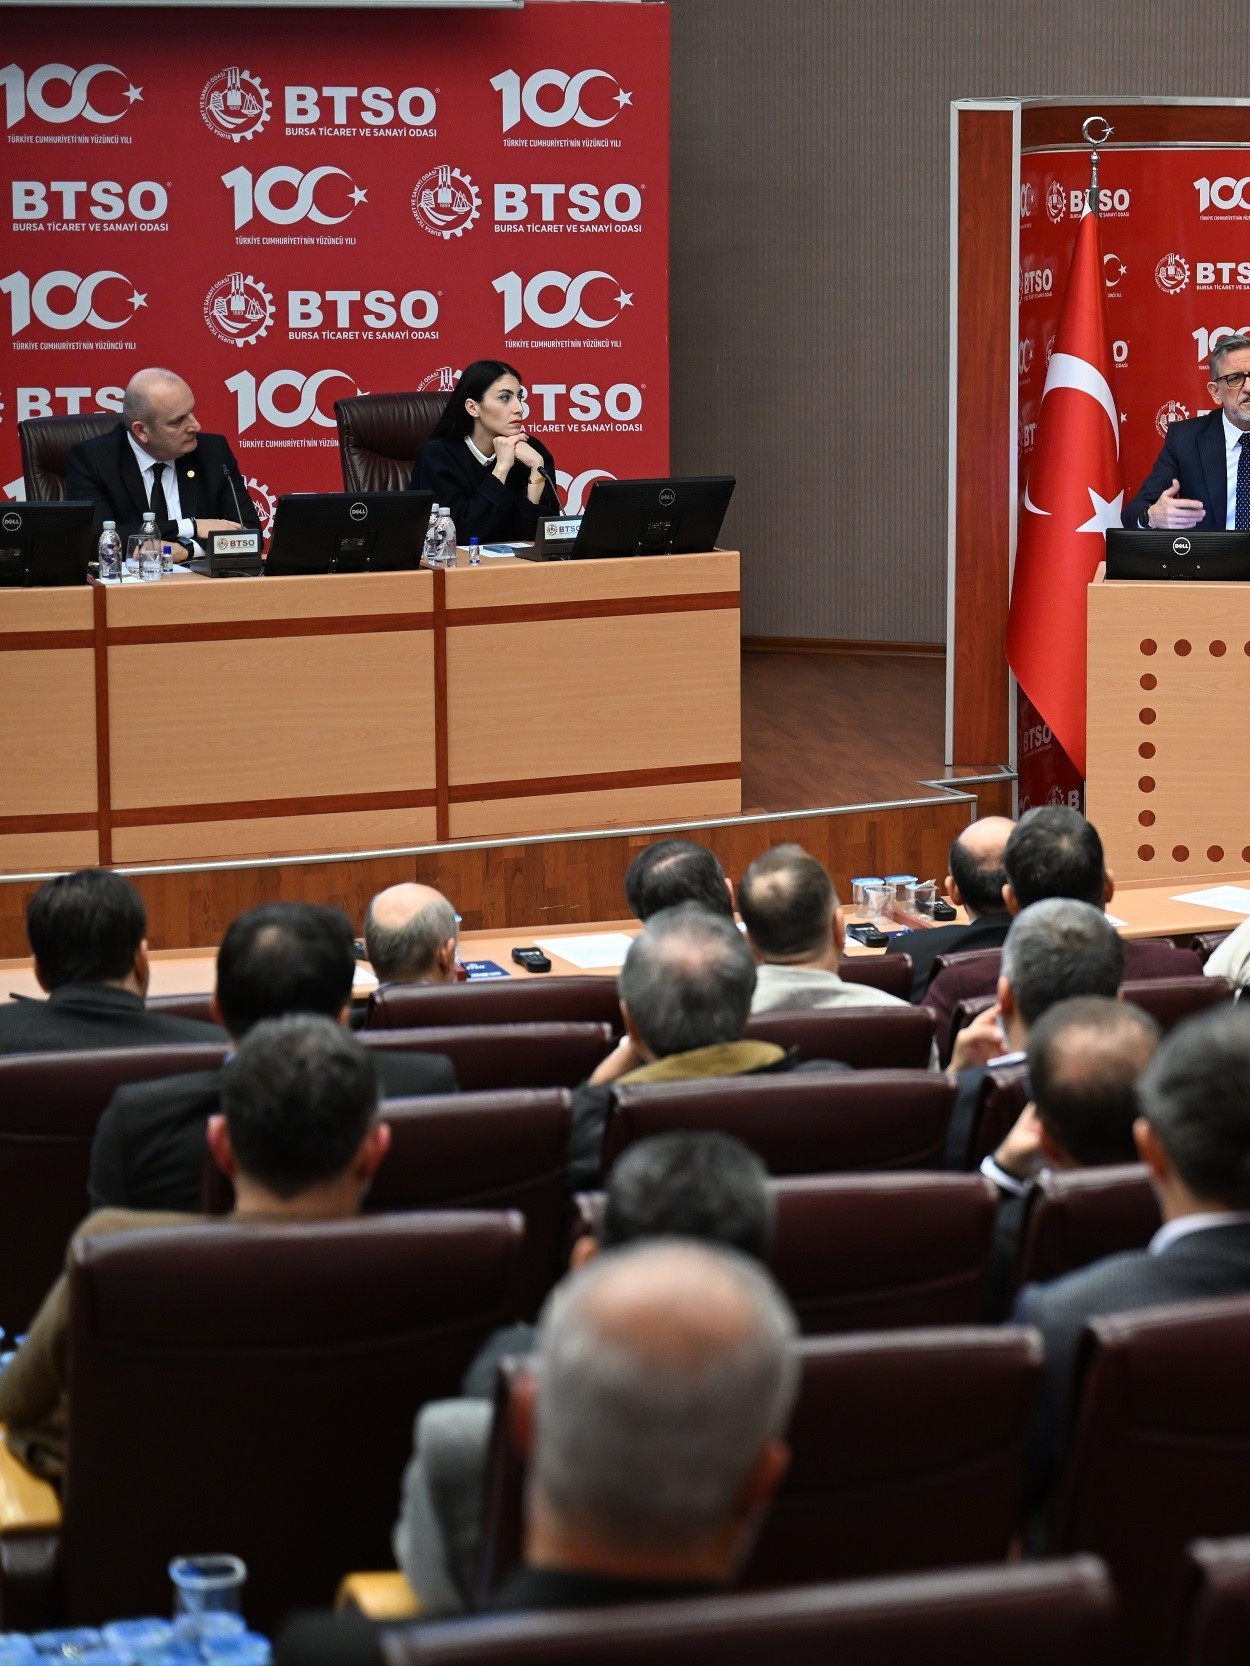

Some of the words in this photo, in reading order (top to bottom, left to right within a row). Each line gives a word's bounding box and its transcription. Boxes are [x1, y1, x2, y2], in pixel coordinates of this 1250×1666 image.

[286, 128, 316, 136] BURSA
[319, 127, 357, 136] TİCARET
[359, 128, 371, 136] VE
[373, 127, 406, 137] SANAYİ
[409, 128, 437, 137] ODASI
[8, 133, 33, 144] TÜRKİYE
[35, 133, 89, 144] CUMHURİYETİ'NİN
[91, 134, 119, 144] YÜZÜNCÜ
[120, 136, 132, 144] YILI
[503, 137, 528, 148] TÜRKİYE
[530, 137, 580, 148] CUMHURİYETİ'NİN
[582, 137, 608, 148] YÜZÜNCÜ
[610, 139, 621, 148] YILI
[1070, 189, 1130, 212] BSO
[13, 222, 44, 232] BURSA
[47, 221, 86, 232] TİCARET
[89, 222, 100, 232] VE
[103, 221, 137, 232] SANAYİ
[140, 222, 168, 232] ODASI
[495, 224, 524, 233] BURSA
[527, 222, 564, 233] TİCARET
[566, 224, 577, 233] VE
[580, 222, 612, 233] SANAYİ
[615, 224, 641, 233] ODASI
[236, 235, 260, 245] TÜRKİYE
[262, 235, 314, 245] CUMHURİYETİ'NİN
[316, 235, 343, 246] YÜZÜNCÜ
[345, 237, 356, 245] YILI
[289, 331, 319, 340] BURSA
[322, 329, 359, 340] TİCARET
[362, 331, 373, 340] VE
[376, 329, 408, 340] SANAYİ
[411, 331, 438, 340] ODASI
[13, 340, 38, 351] TÜRKİYE
[40, 340, 93, 351] CUMHURİYETİ'NİN
[95, 340, 123, 350] YÜZÜNCÜ
[125, 341, 136, 350] YILI
[505, 338, 529, 349] TÜRKİYE
[531, 338, 581, 349] CUMHURİYETİ'NİN
[583, 338, 609, 348] YÜZÜNCÜ
[611, 340, 621, 348] YILI
[528, 422, 565, 433] TİCARET
[567, 423, 578, 433] VE
[581, 421, 613, 432] SANAYİ
[616, 423, 642, 432] ODASI
[239, 438, 264, 448] TÜRKİYE
[319, 437, 339, 448] YÜZÜN
[230, 539, 255, 547] BTSO
